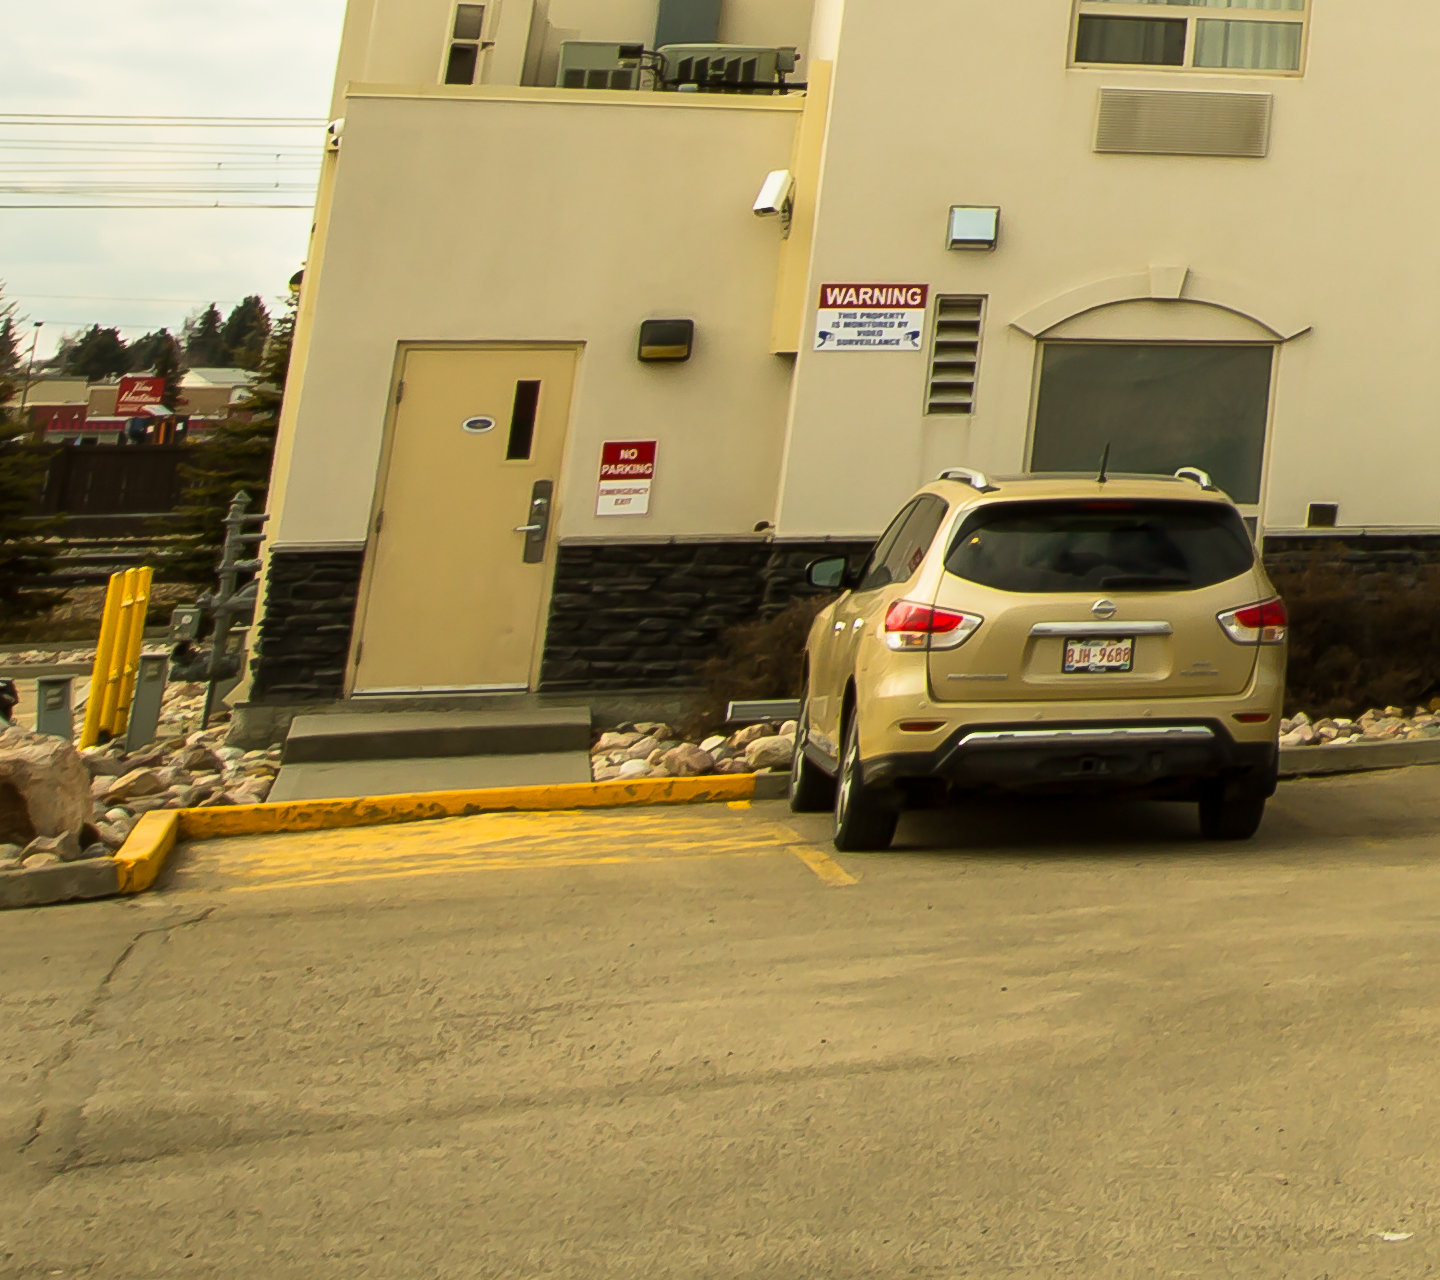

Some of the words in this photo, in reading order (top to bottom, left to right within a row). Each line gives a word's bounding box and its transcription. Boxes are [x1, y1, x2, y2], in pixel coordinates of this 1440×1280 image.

[826, 287, 922, 306] WARNING
[619, 448, 638, 460] NO
[601, 463, 653, 475] PARKING
